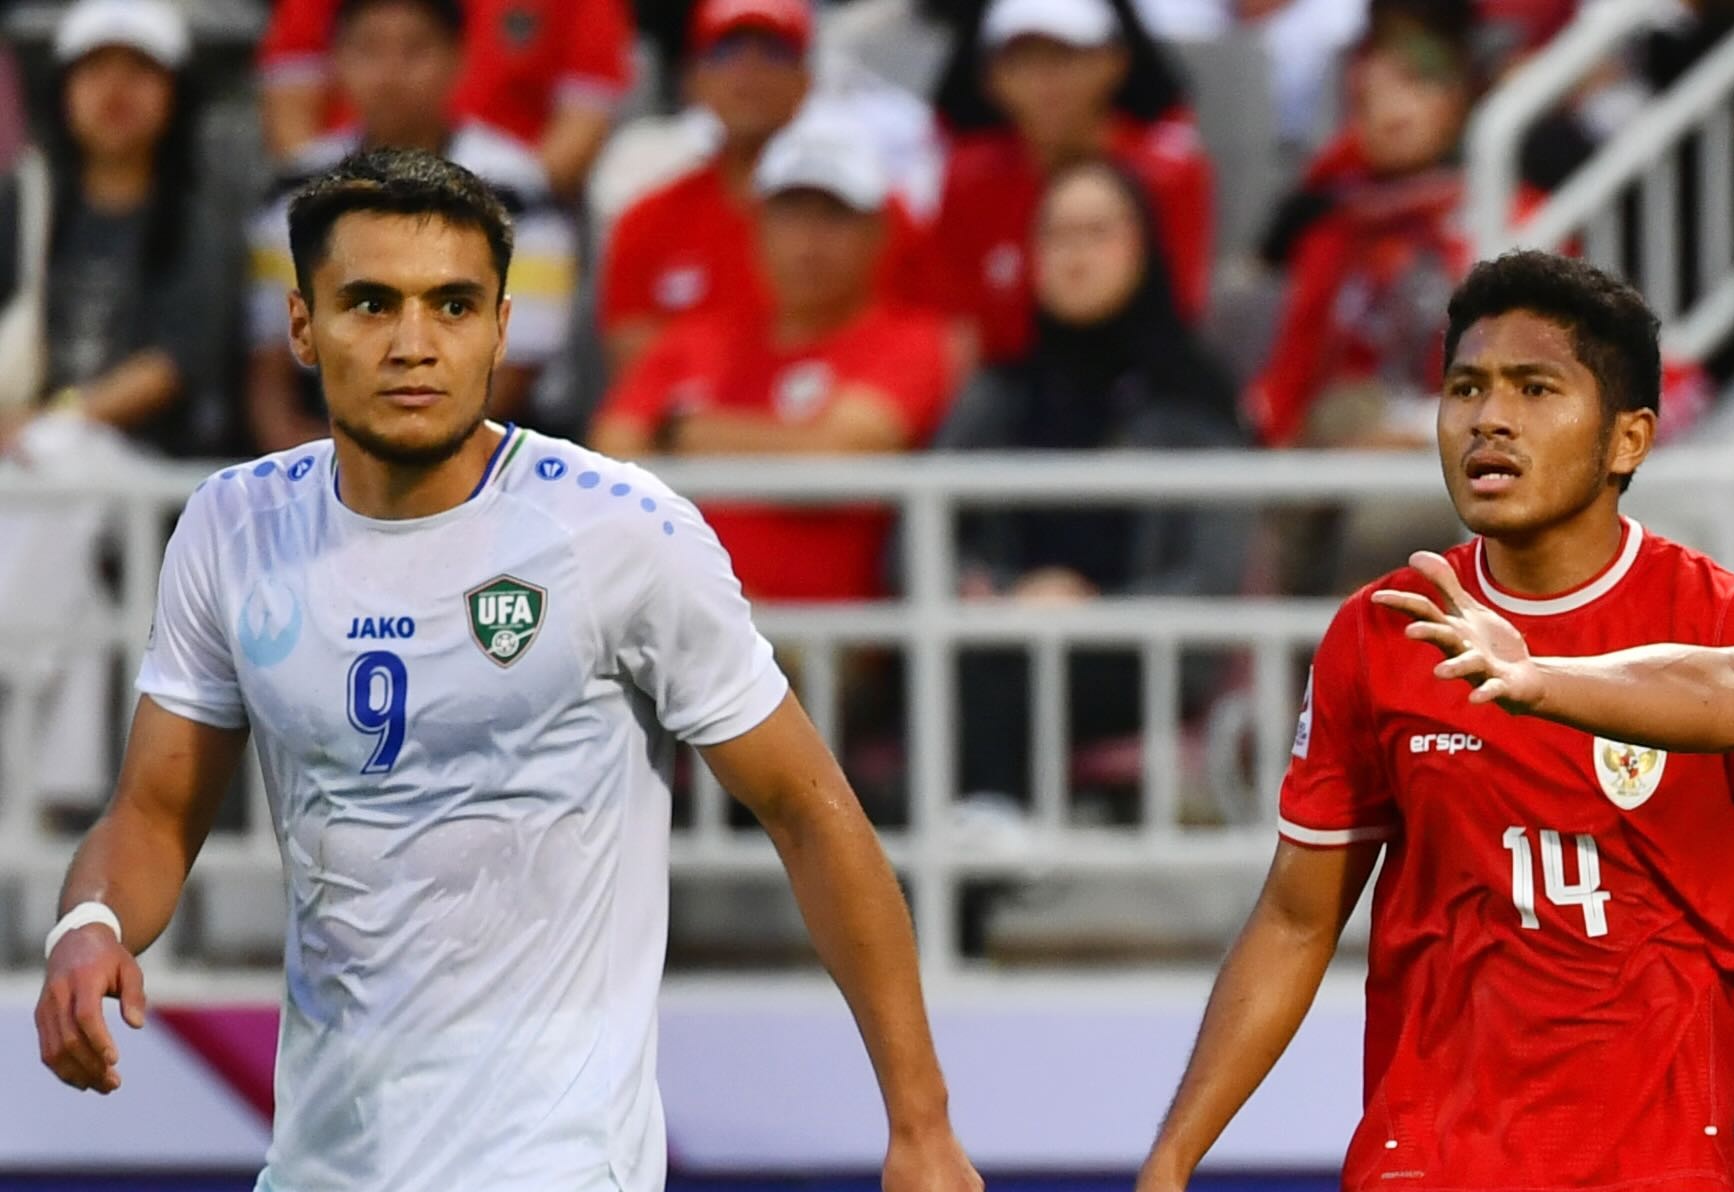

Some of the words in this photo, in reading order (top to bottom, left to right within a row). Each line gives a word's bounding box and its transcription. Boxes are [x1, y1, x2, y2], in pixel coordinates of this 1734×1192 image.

[478, 595, 533, 625] UFA
[347, 617, 415, 639] JAKO
[347, 650, 407, 774] 9
[1410, 733, 1483, 755] erspo
[1503, 826, 1611, 938] 14
